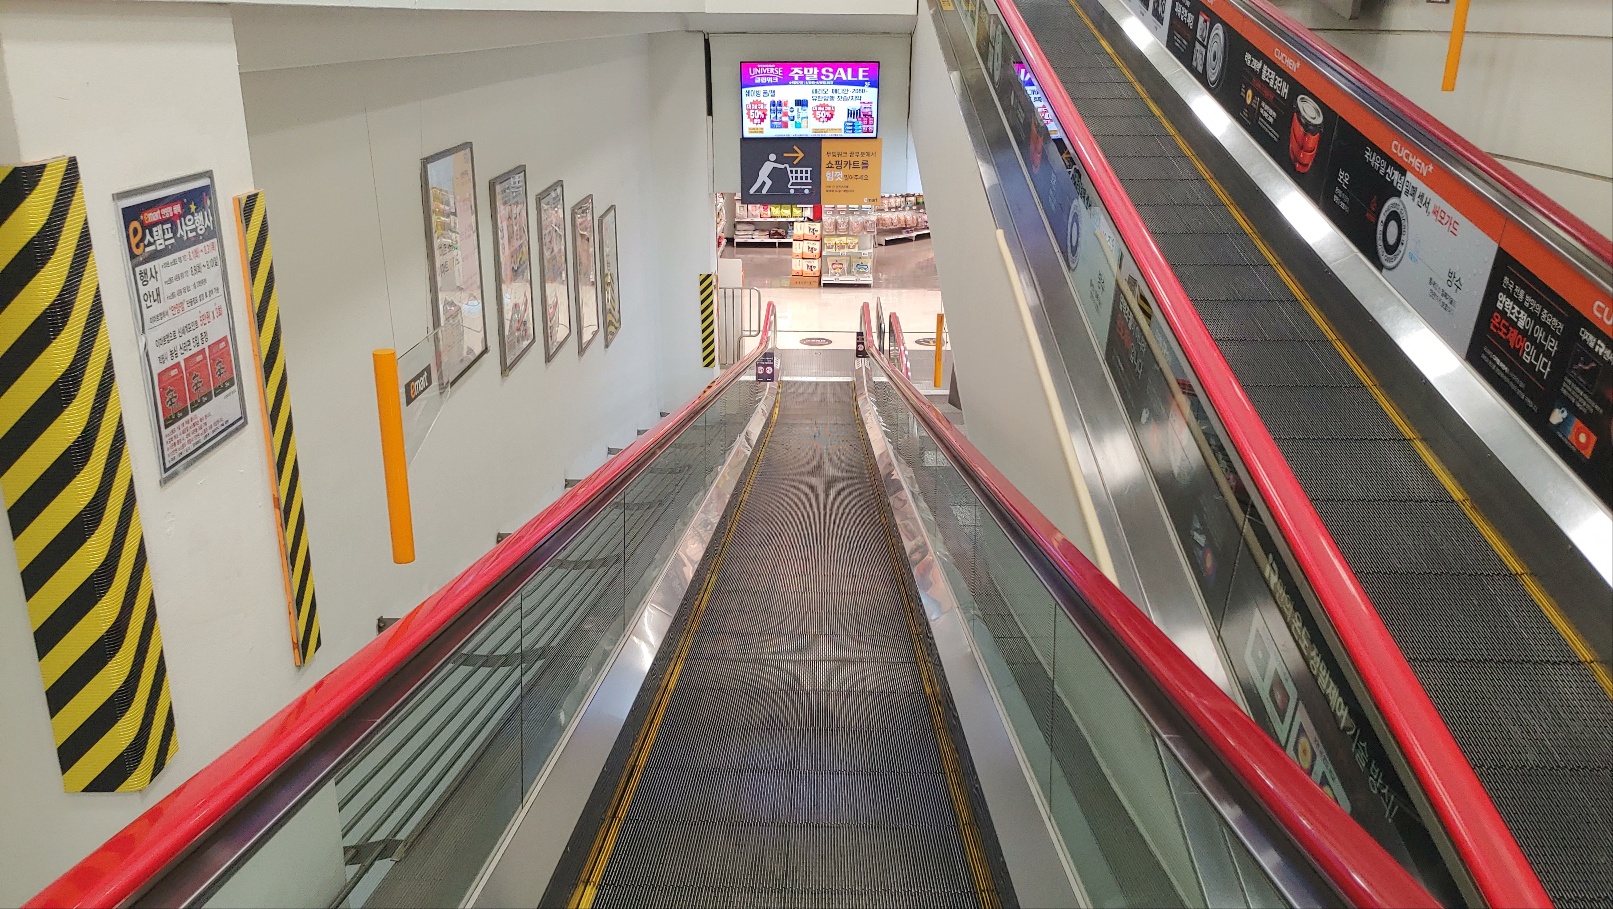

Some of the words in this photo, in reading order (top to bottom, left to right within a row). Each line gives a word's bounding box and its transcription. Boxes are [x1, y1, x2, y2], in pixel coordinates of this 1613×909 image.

[749, 67, 783, 76] UNIVERSE
[1274, 48, 1297, 72] CUCHEN
[788, 67, 819, 81] 주말
[821, 67, 870, 81] SALE
[750, 109, 765, 119] 50%
[825, 160, 870, 170] 쇼핑카트를
[1391, 140, 1429, 177] CUCHEN
[825, 171, 843, 181] 힘껏
[1337, 168, 1350, 190] 보온
[1364, 146, 1387, 176] 국내유일
[1385, 166, 1406, 191] 신개념
[1431, 203, 1460, 237] 써모가드
[176, 208, 214, 241] 사은행사
[138, 264, 159, 287] 행사
[1447, 268, 1463, 293] 방수
[142, 286, 162, 310] 안내
[1502, 276, 1515, 293] 한국
[1513, 286, 1526, 302] 전통
[1524, 291, 1542, 316] 밥맛의
[1540, 308, 1565, 336] 중요한건
[1496, 292, 1534, 335] 압력조절이
[1533, 325, 1558, 357] 아니라
[1489, 311, 1552, 380] 온도제어입니다
[410, 371, 429, 399] emart
[1367, 759, 1399, 824] 방식!
